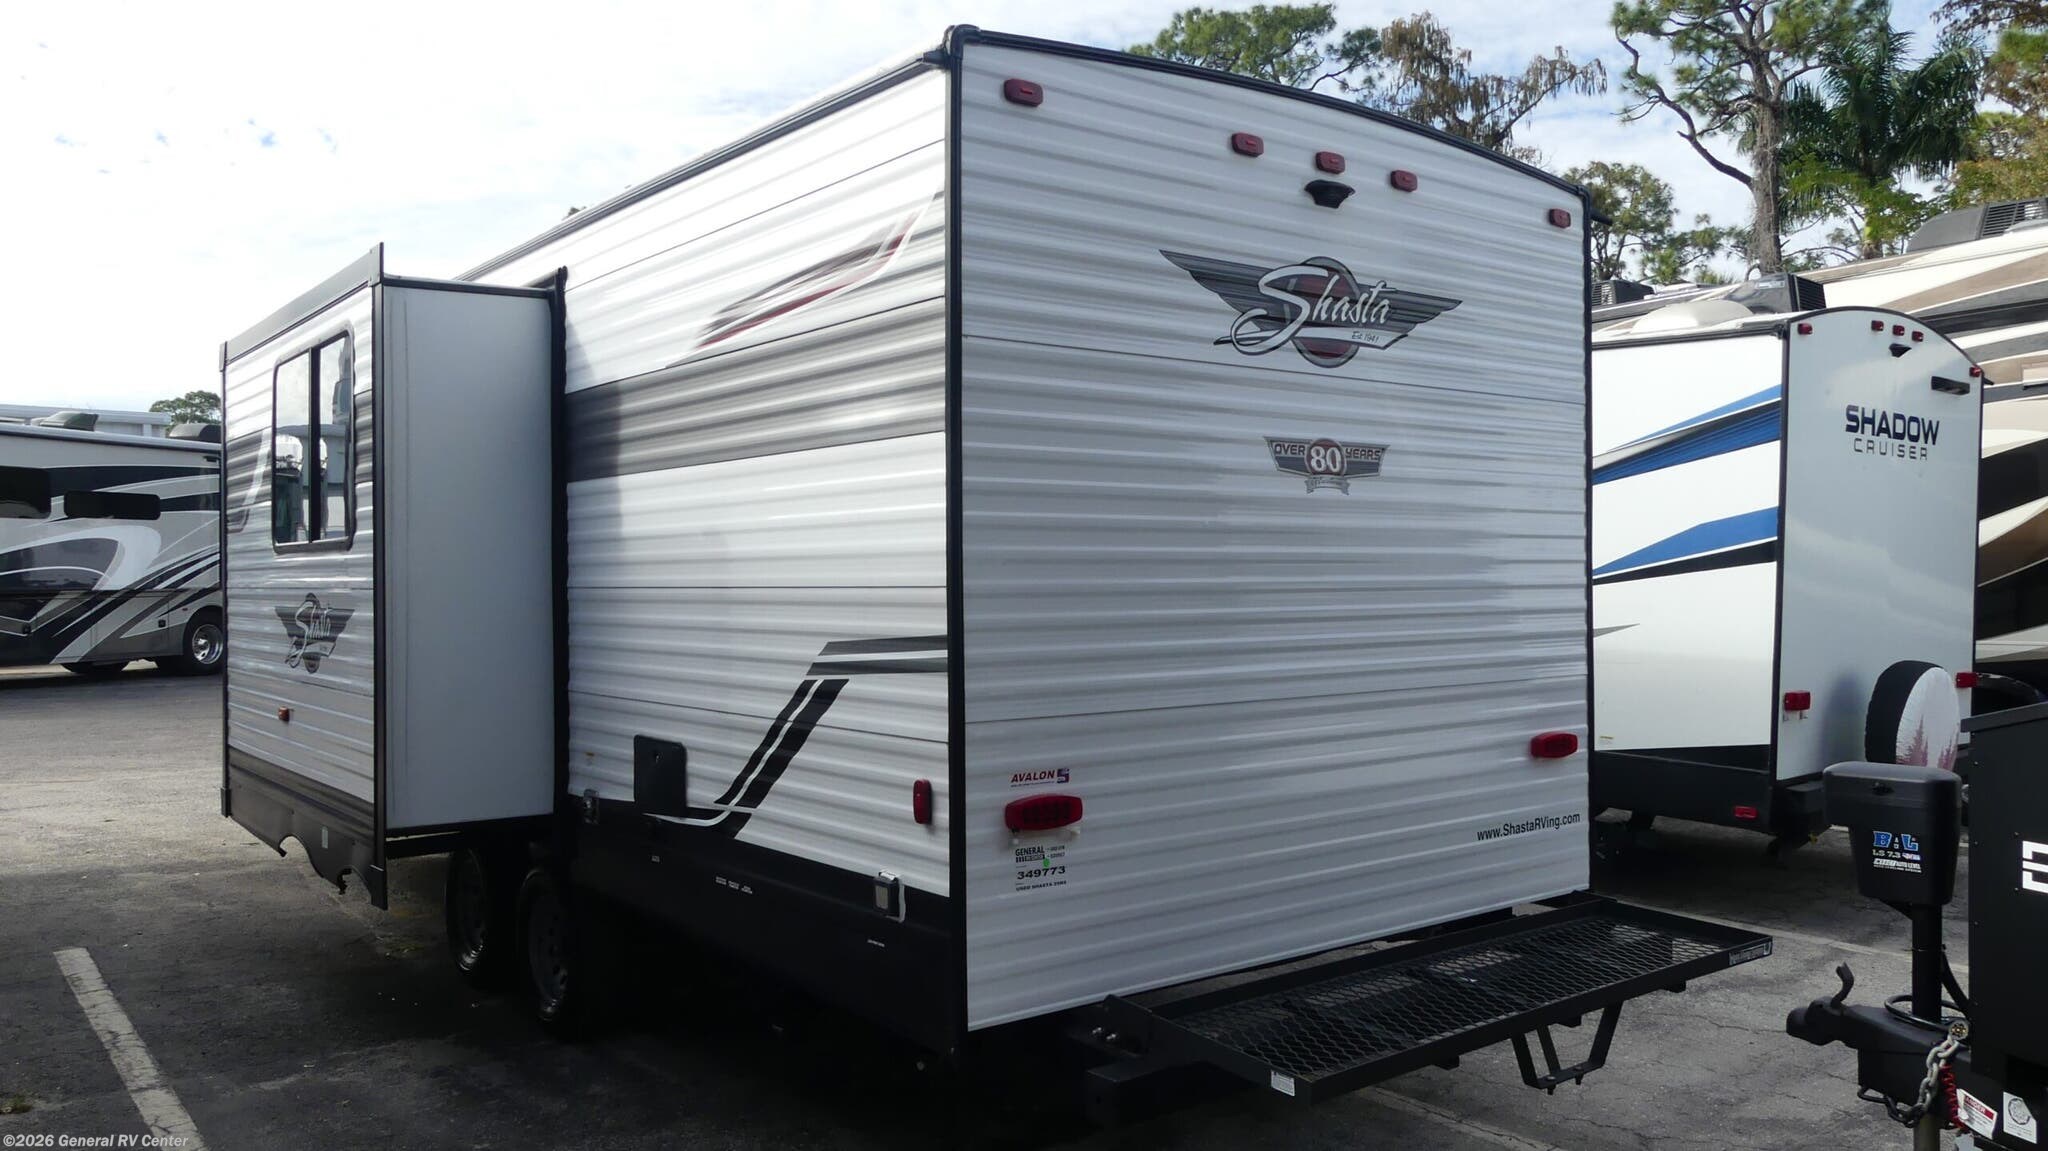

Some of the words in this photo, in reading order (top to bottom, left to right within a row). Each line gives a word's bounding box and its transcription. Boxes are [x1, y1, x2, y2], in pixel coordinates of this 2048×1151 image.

[1214, 264, 1396, 354] Shasta
[1845, 404, 1940, 446] SHADOW
[1274, 443, 1306, 456] OVER
[1310, 446, 1341, 473] 80
[1345, 448, 1380, 460] YEARS
[1853, 437, 1928, 461] CRUISER
[1010, 770, 1055, 783] AVALON
[1477, 813, 1581, 841] www.ShastaRVing.com
[1015, 845, 1045, 857] GENERAL
[1017, 865, 1066, 880] 349773
